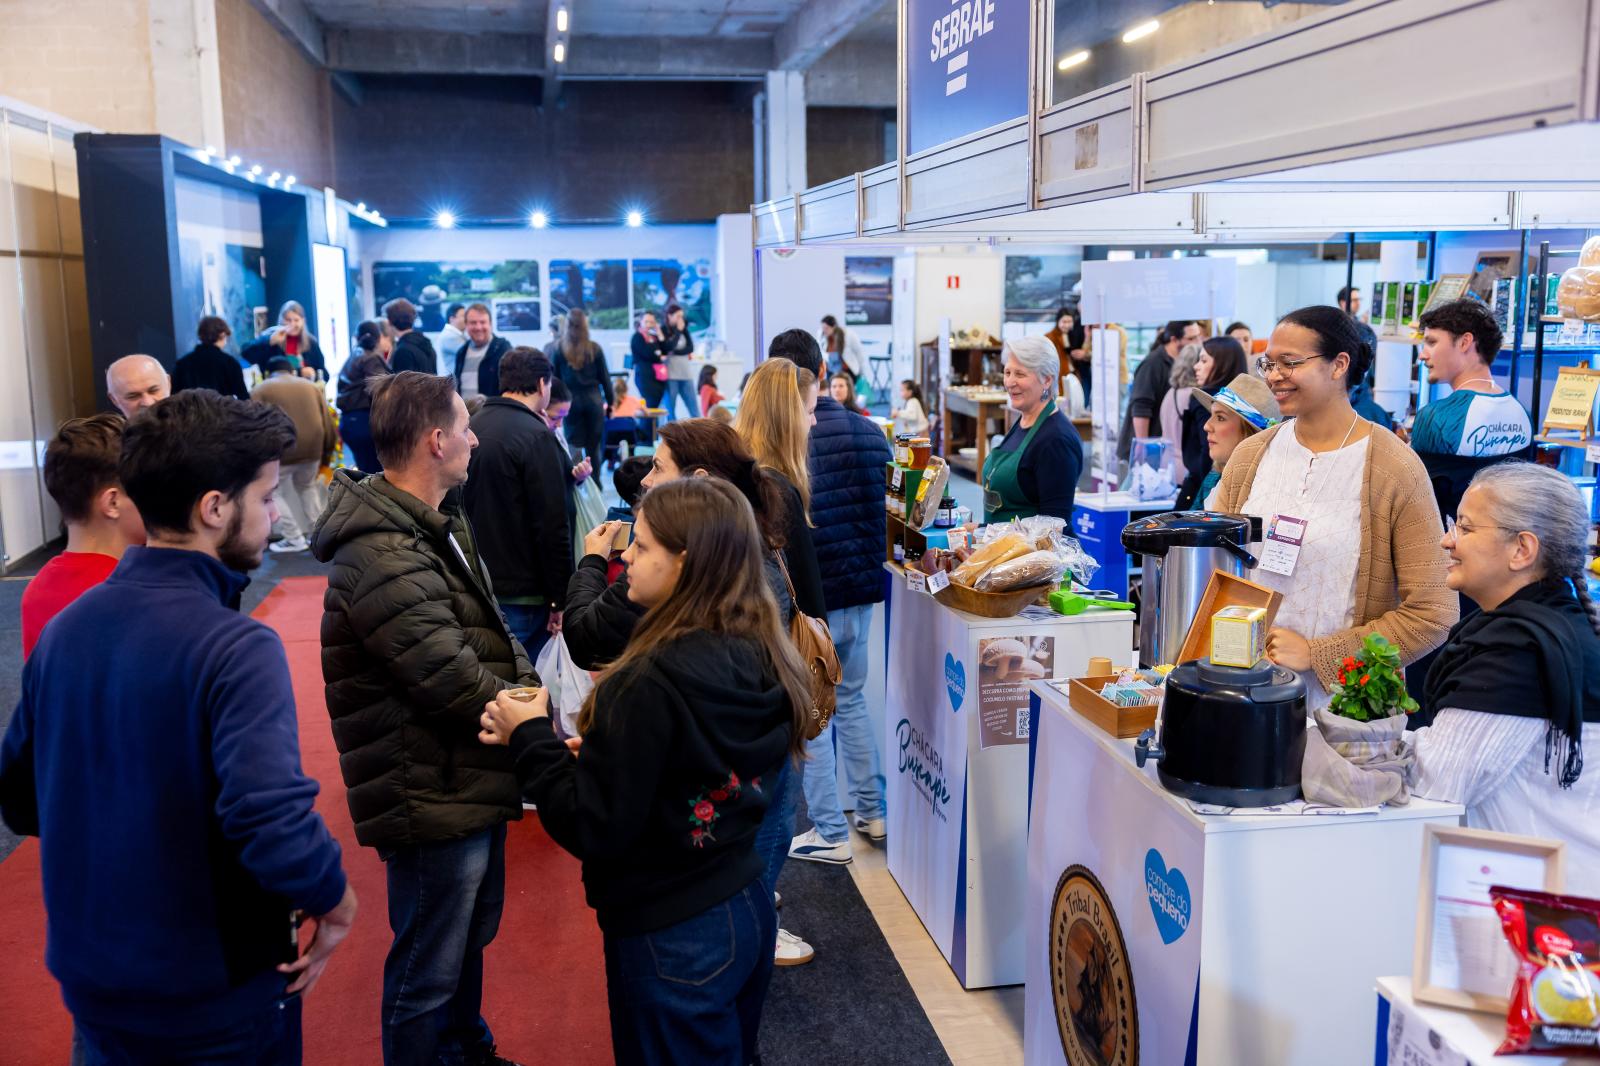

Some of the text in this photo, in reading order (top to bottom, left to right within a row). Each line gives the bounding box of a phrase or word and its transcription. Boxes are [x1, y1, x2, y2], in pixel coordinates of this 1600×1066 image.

[930, 0, 995, 62] SEBRAE
[1488, 421, 1523, 433] CHÁCARA
[1147, 867, 1188, 914] compre do
[1147, 881, 1187, 930] pequeno
[1066, 889, 1120, 967] Tribal Brasil
